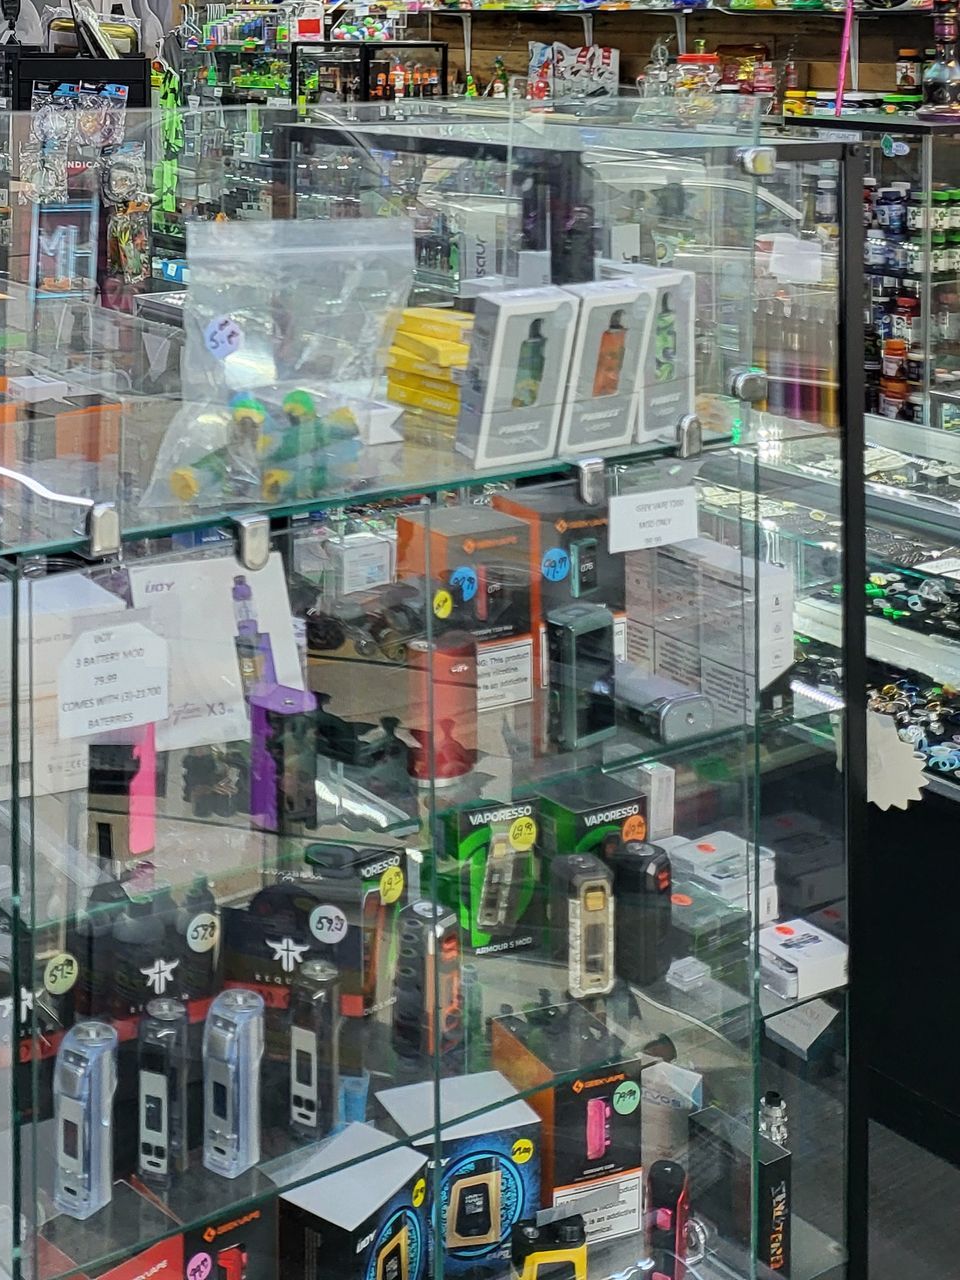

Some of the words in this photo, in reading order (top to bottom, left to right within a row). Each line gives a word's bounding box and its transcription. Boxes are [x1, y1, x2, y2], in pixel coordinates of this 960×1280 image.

[67, 161, 100, 169] NDICA
[469, 805, 532, 826] VAPORESSO
[584, 805, 639, 827] VAPORESSO
[361, 855, 400, 878] ORESSO
[606, 1208, 636, 1221] addictive
